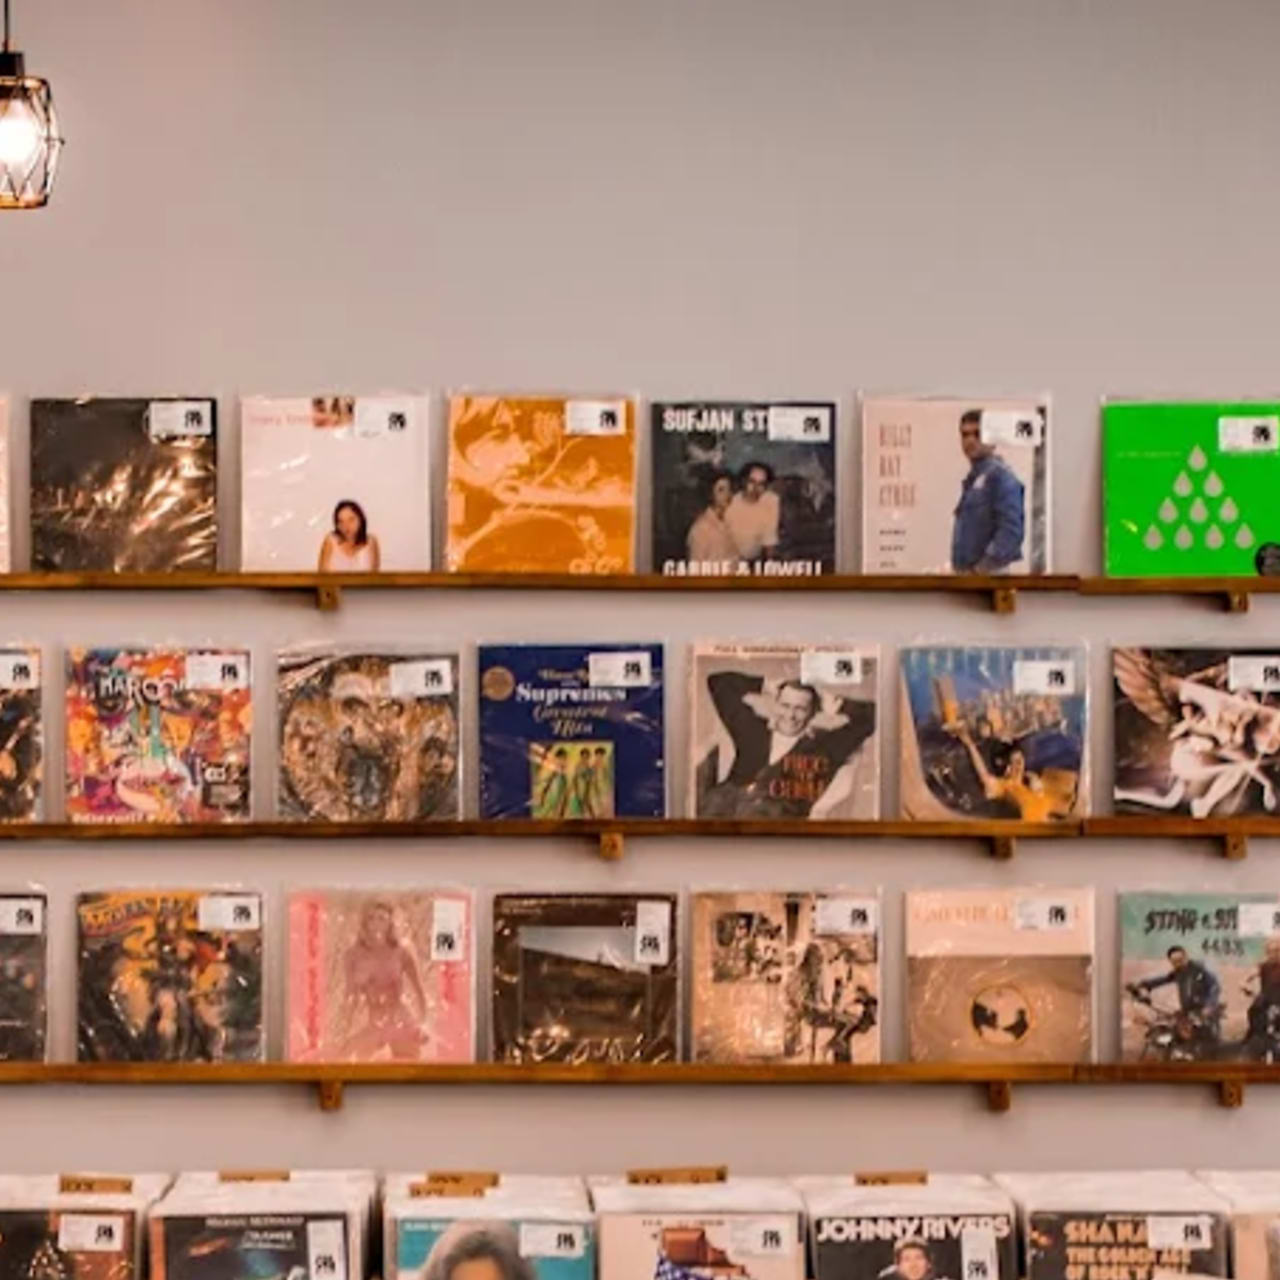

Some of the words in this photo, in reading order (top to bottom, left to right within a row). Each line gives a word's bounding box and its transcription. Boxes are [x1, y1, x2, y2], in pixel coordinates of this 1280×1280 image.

[663, 408, 734, 431] SUFJAN
[516, 682, 627, 705] Supremes
[818, 1219, 918, 1241] JOHNNY
